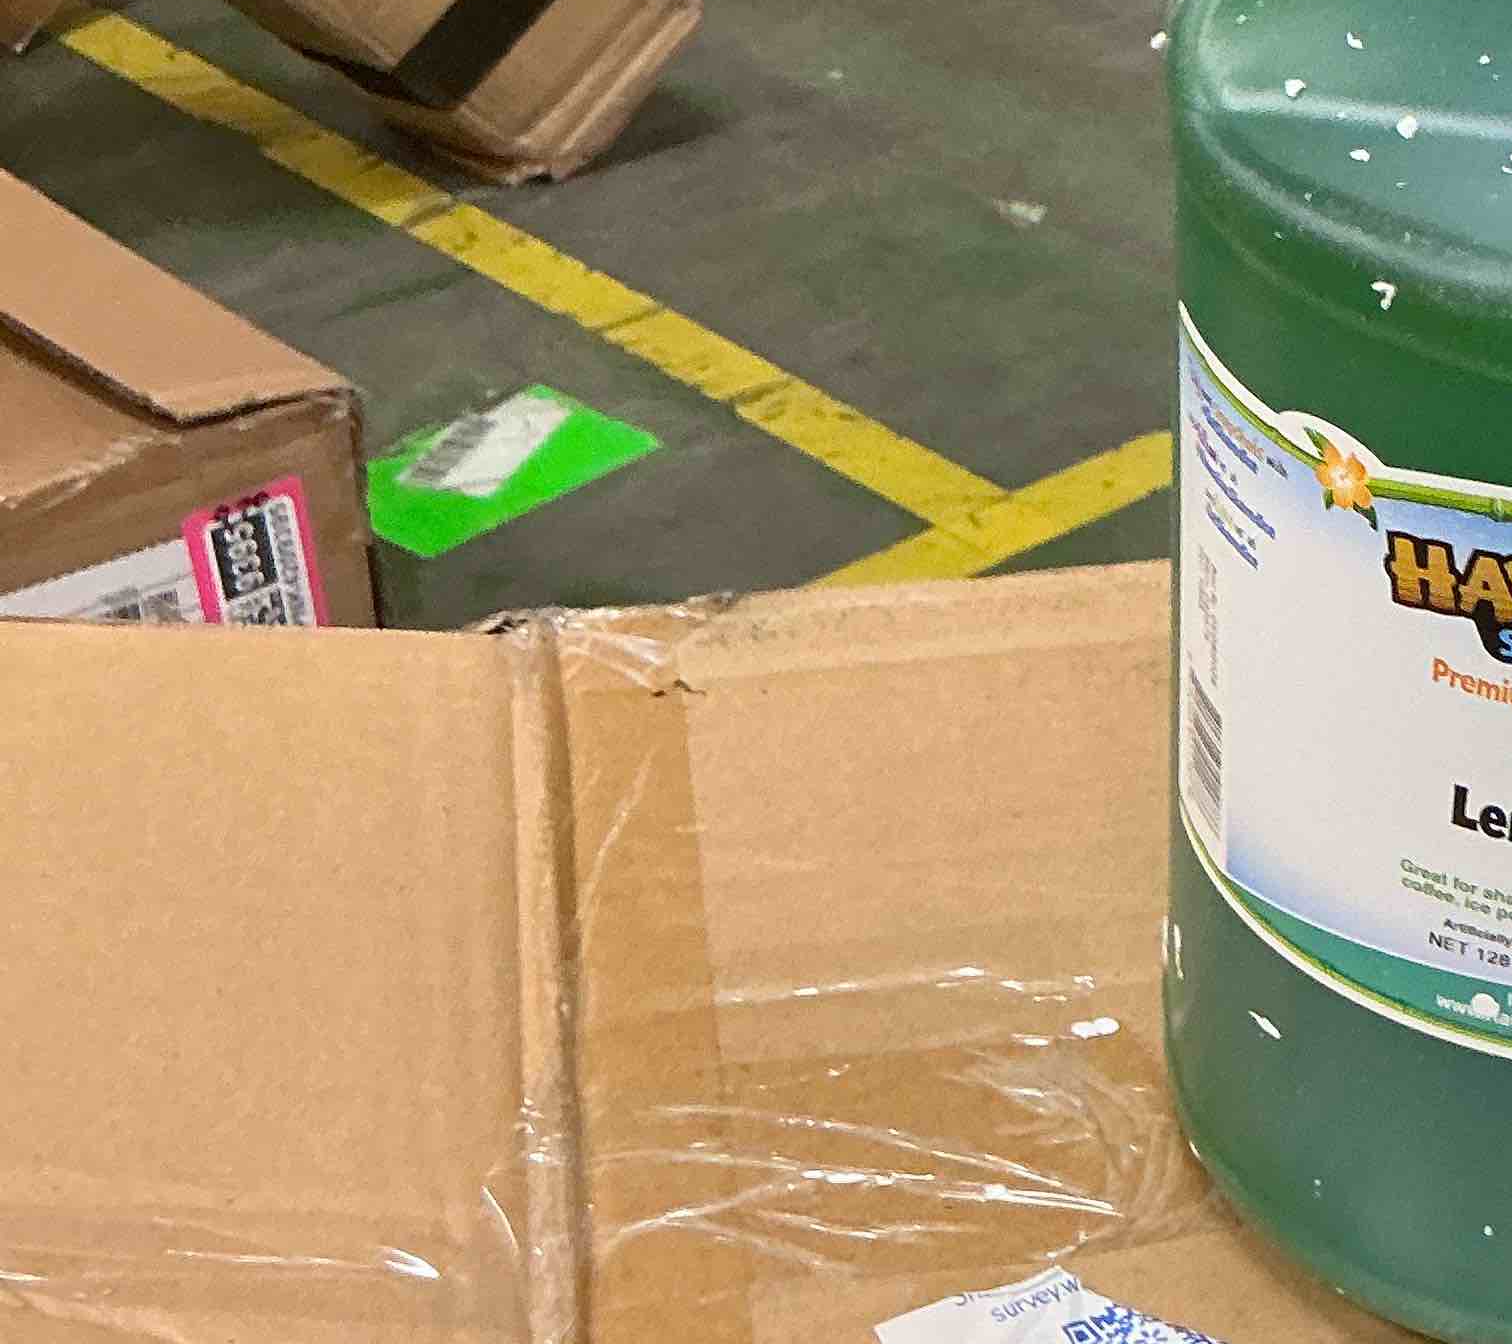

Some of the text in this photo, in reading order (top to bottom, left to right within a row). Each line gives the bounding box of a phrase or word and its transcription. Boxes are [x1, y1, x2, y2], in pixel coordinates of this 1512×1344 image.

[1454, 876, 1478, 895] for
[1428, 930, 1468, 955] NET
[1477, 947, 1512, 968] 128
